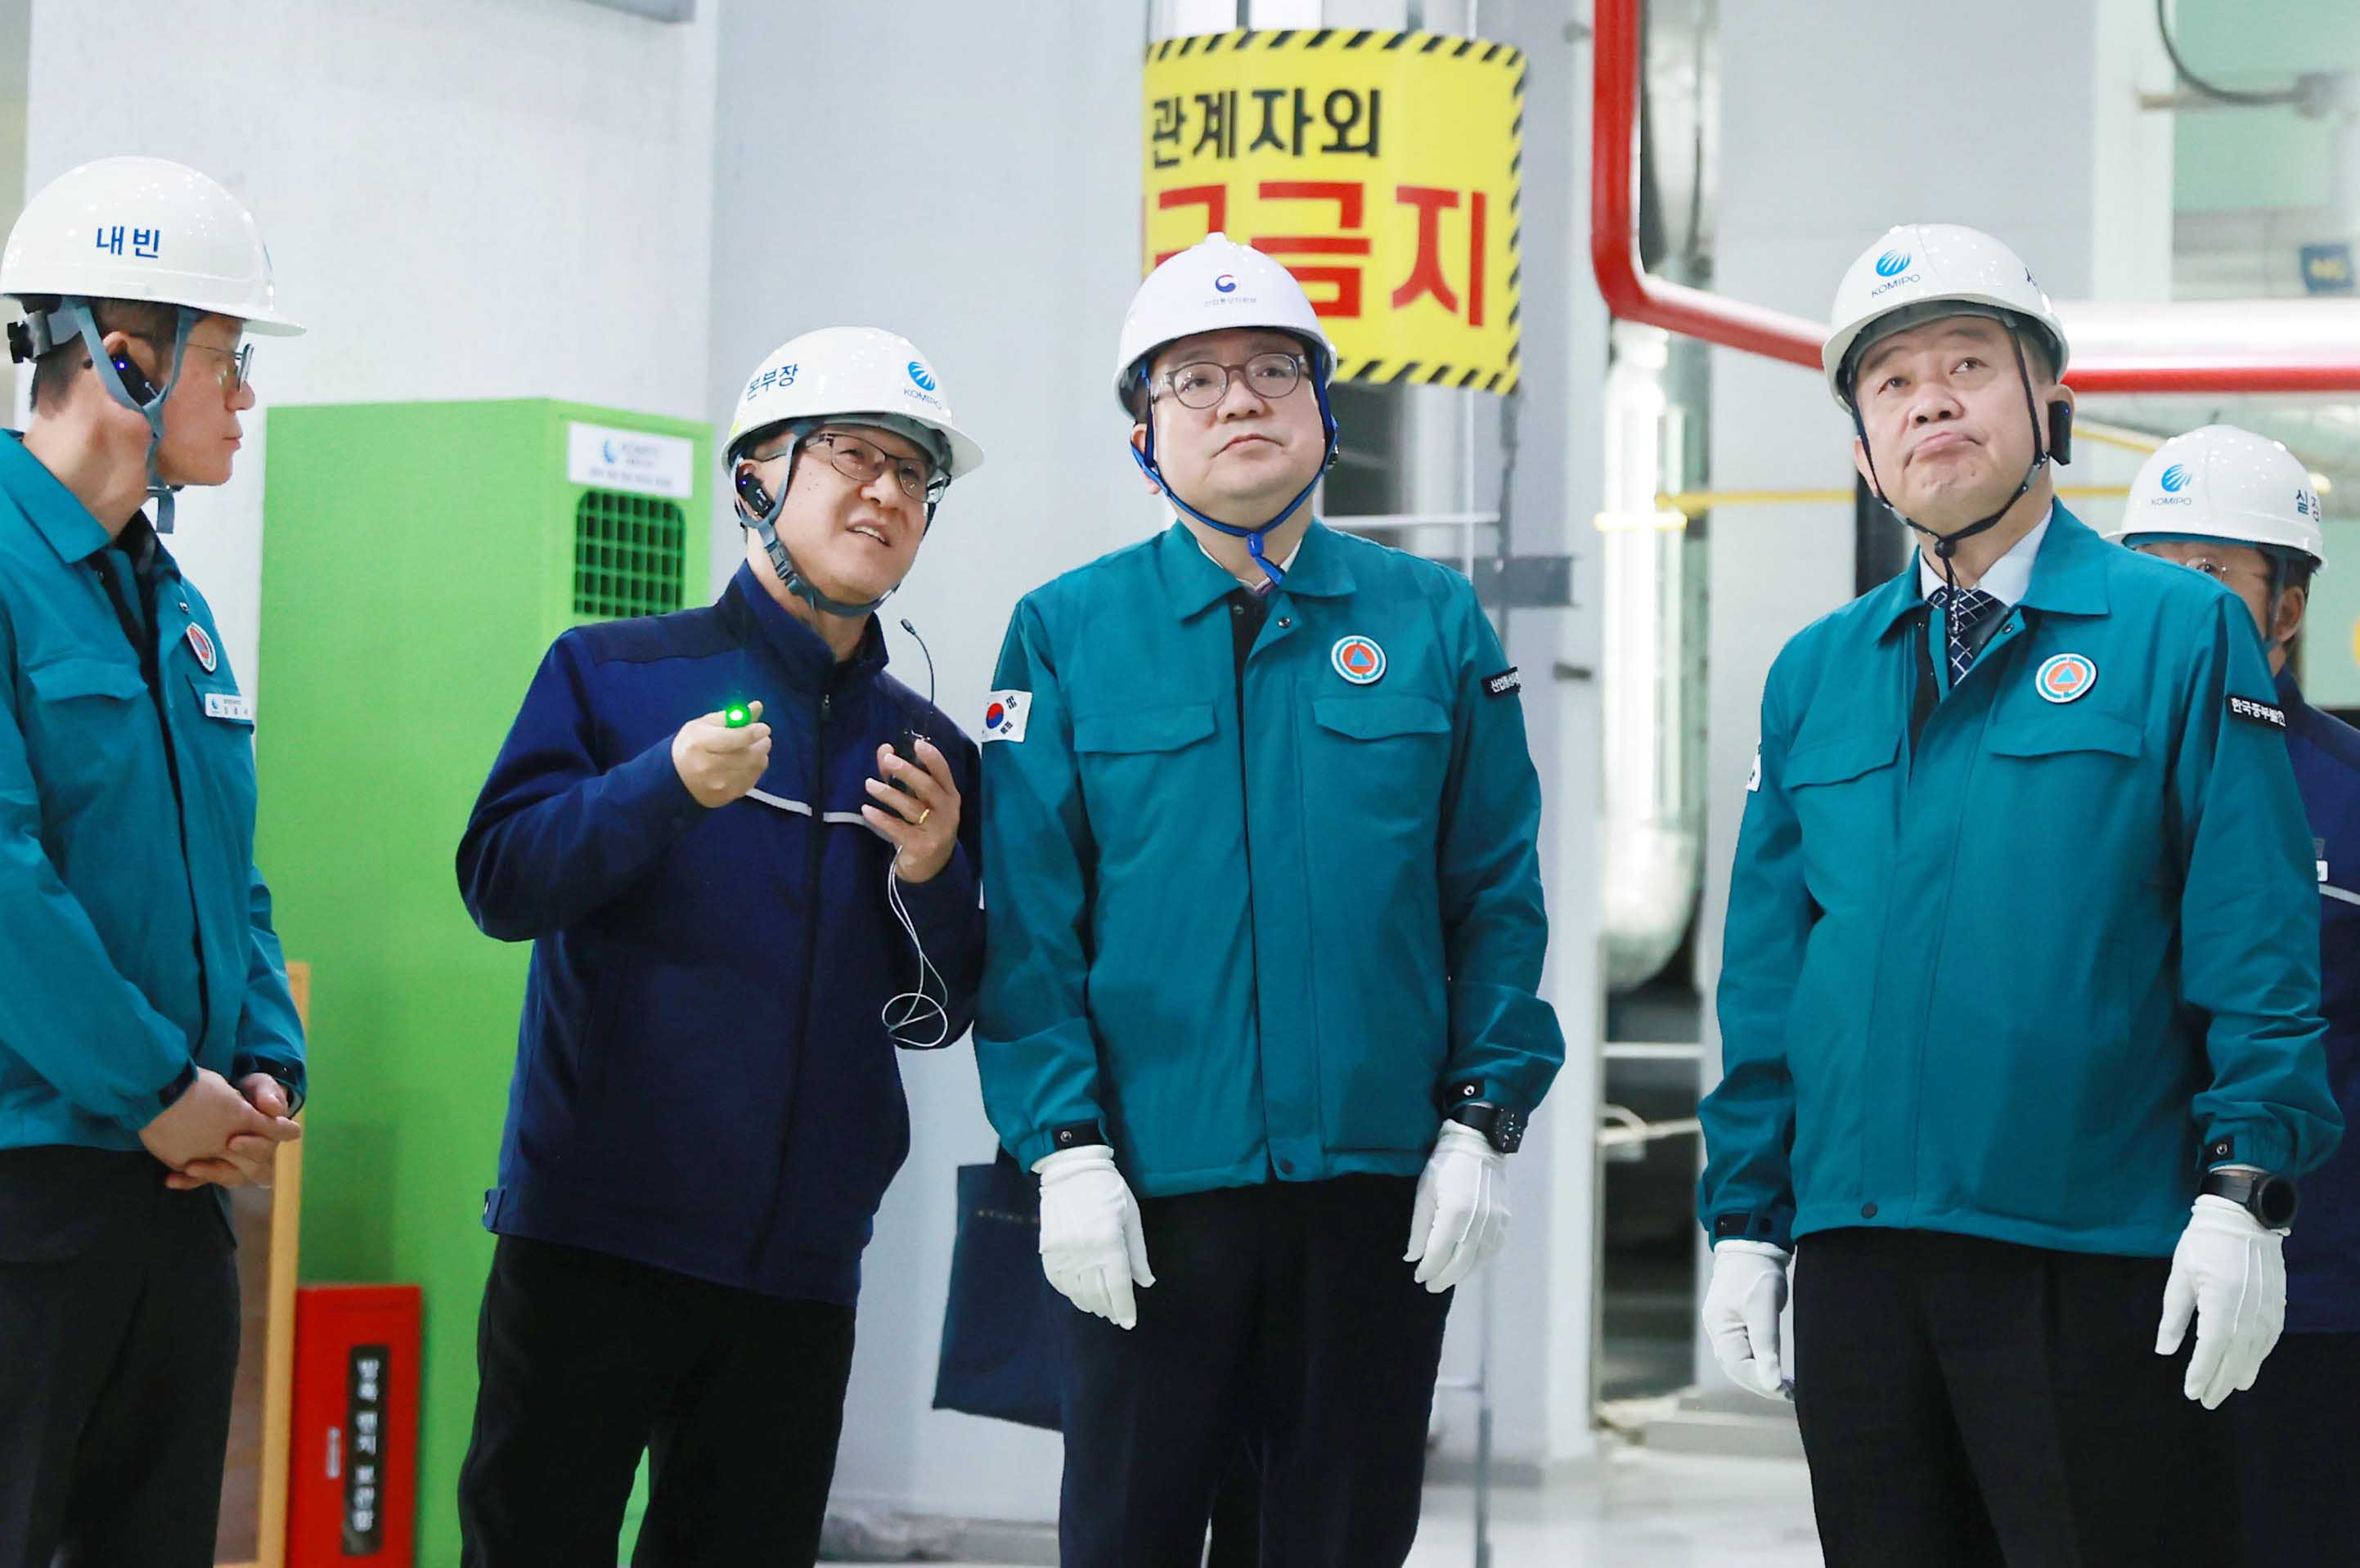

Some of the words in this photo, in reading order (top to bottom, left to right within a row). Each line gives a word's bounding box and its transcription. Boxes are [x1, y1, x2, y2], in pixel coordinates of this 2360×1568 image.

[1152, 88, 1382, 169] 관계자외
[97, 226, 160, 258] 내빈
[1871, 274, 1921, 298] KOMIPO
[903, 389, 942, 410] KOMIPO
[2151, 496, 2192, 505] KOMIPO
